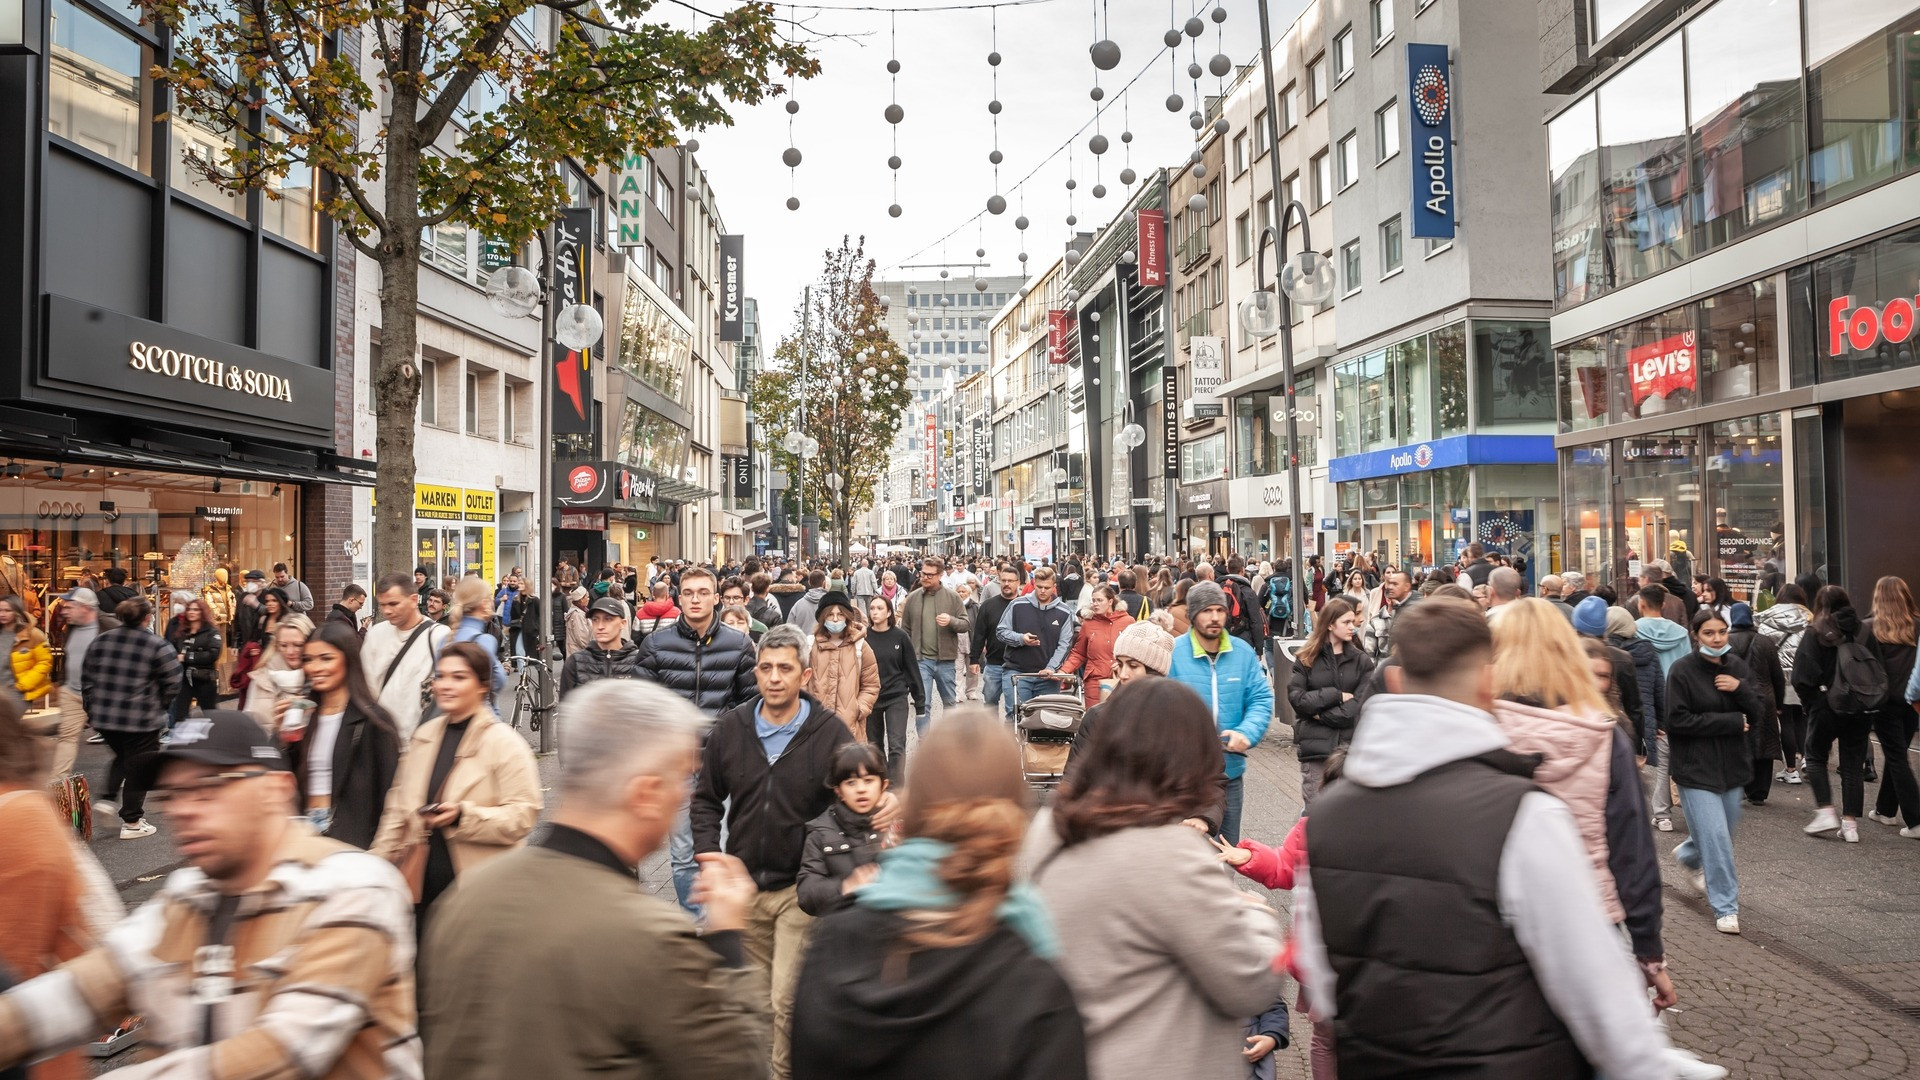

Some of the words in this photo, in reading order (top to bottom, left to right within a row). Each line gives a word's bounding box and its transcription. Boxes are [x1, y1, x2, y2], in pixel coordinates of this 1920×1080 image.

[1425, 136, 1450, 214] Apollo
[725, 255, 739, 321] Kraemer
[129, 341, 224, 388] SCOTCH
[225, 365, 243, 392] &
[243, 369, 293, 403] SODA
[1194, 377, 1222, 387] TATTOO
[1166, 375, 1177, 469] intimissimi
[974, 427, 983, 488] CALZEDONIA
[1390, 452, 1413, 471] Apollo
[422, 490, 457, 507] MARKEN
[466, 494, 493, 509] OUTLET
[1720, 538, 1745, 546] SECOND
[1745, 537, 1773, 545] CHANCE
[1720, 547, 1737, 555] SHOP
